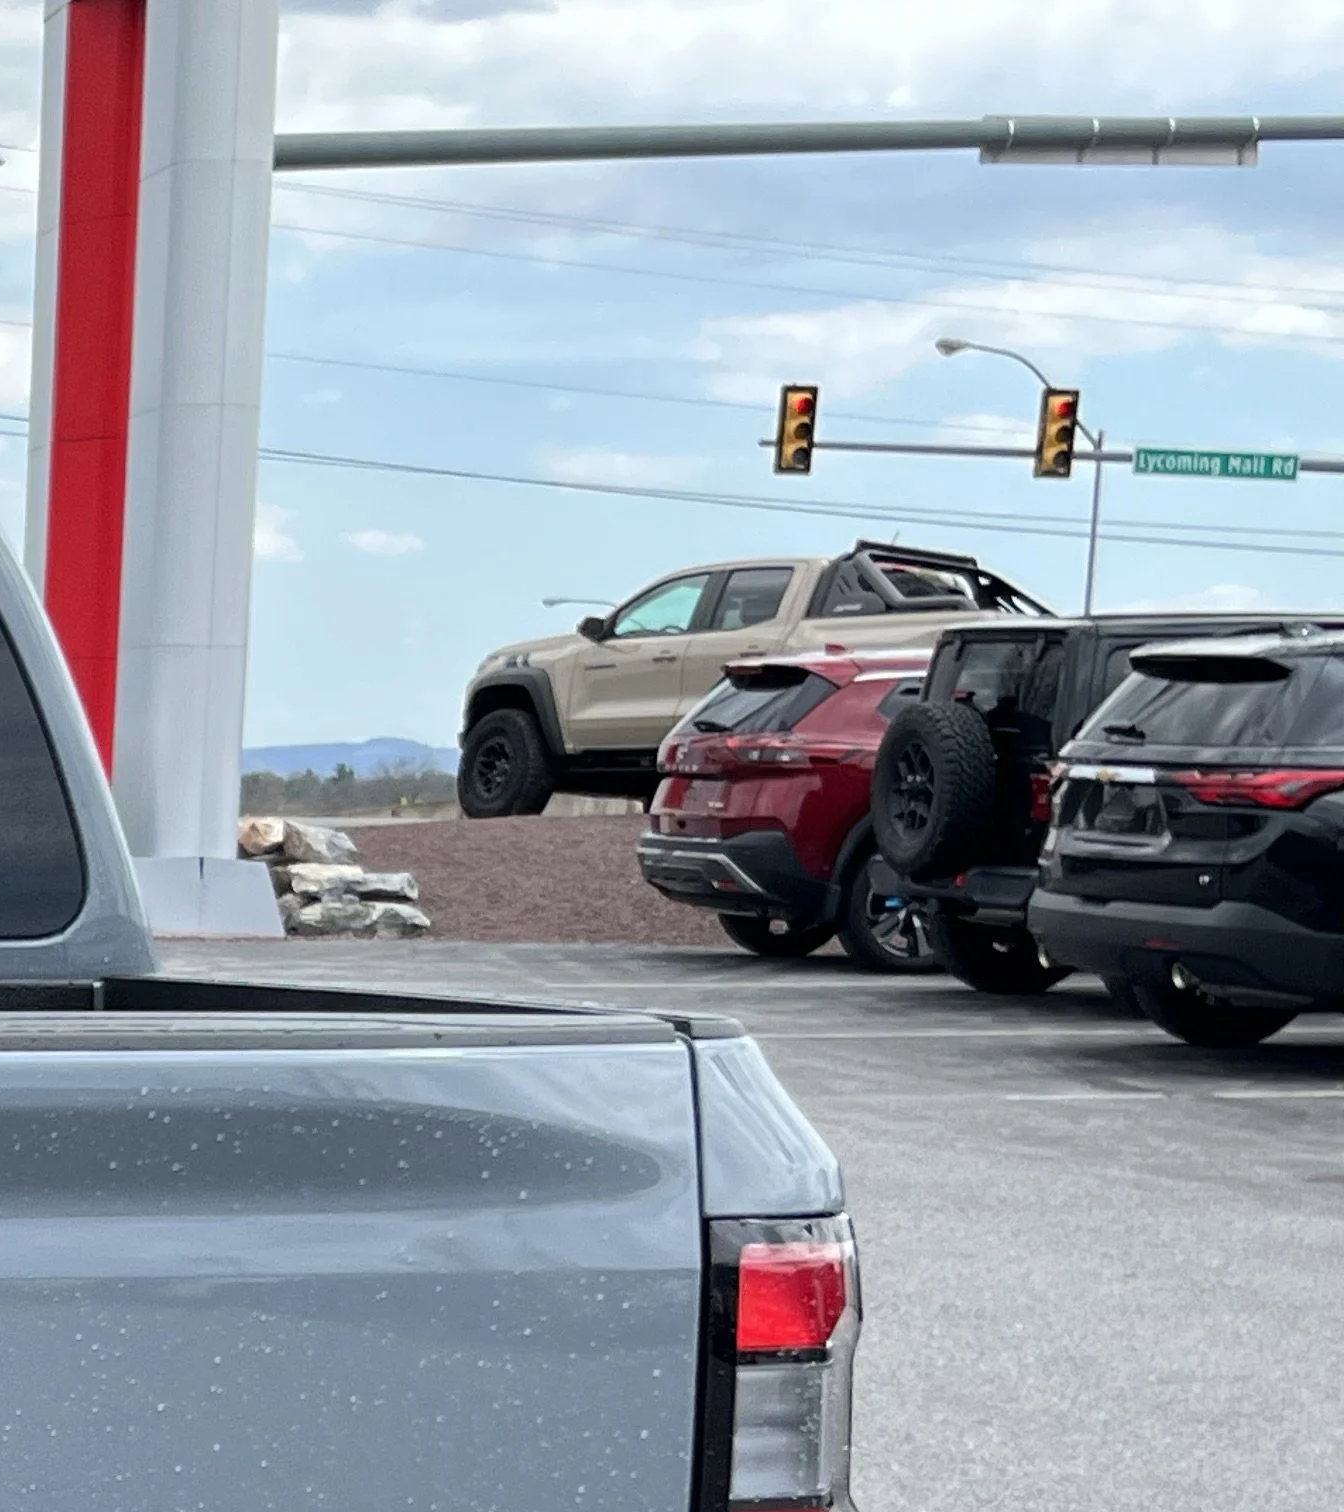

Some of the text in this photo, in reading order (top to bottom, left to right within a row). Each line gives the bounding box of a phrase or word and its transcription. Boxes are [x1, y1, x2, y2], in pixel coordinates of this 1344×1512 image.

[1138, 451, 1296, 476] Lycoming Mall Rd
